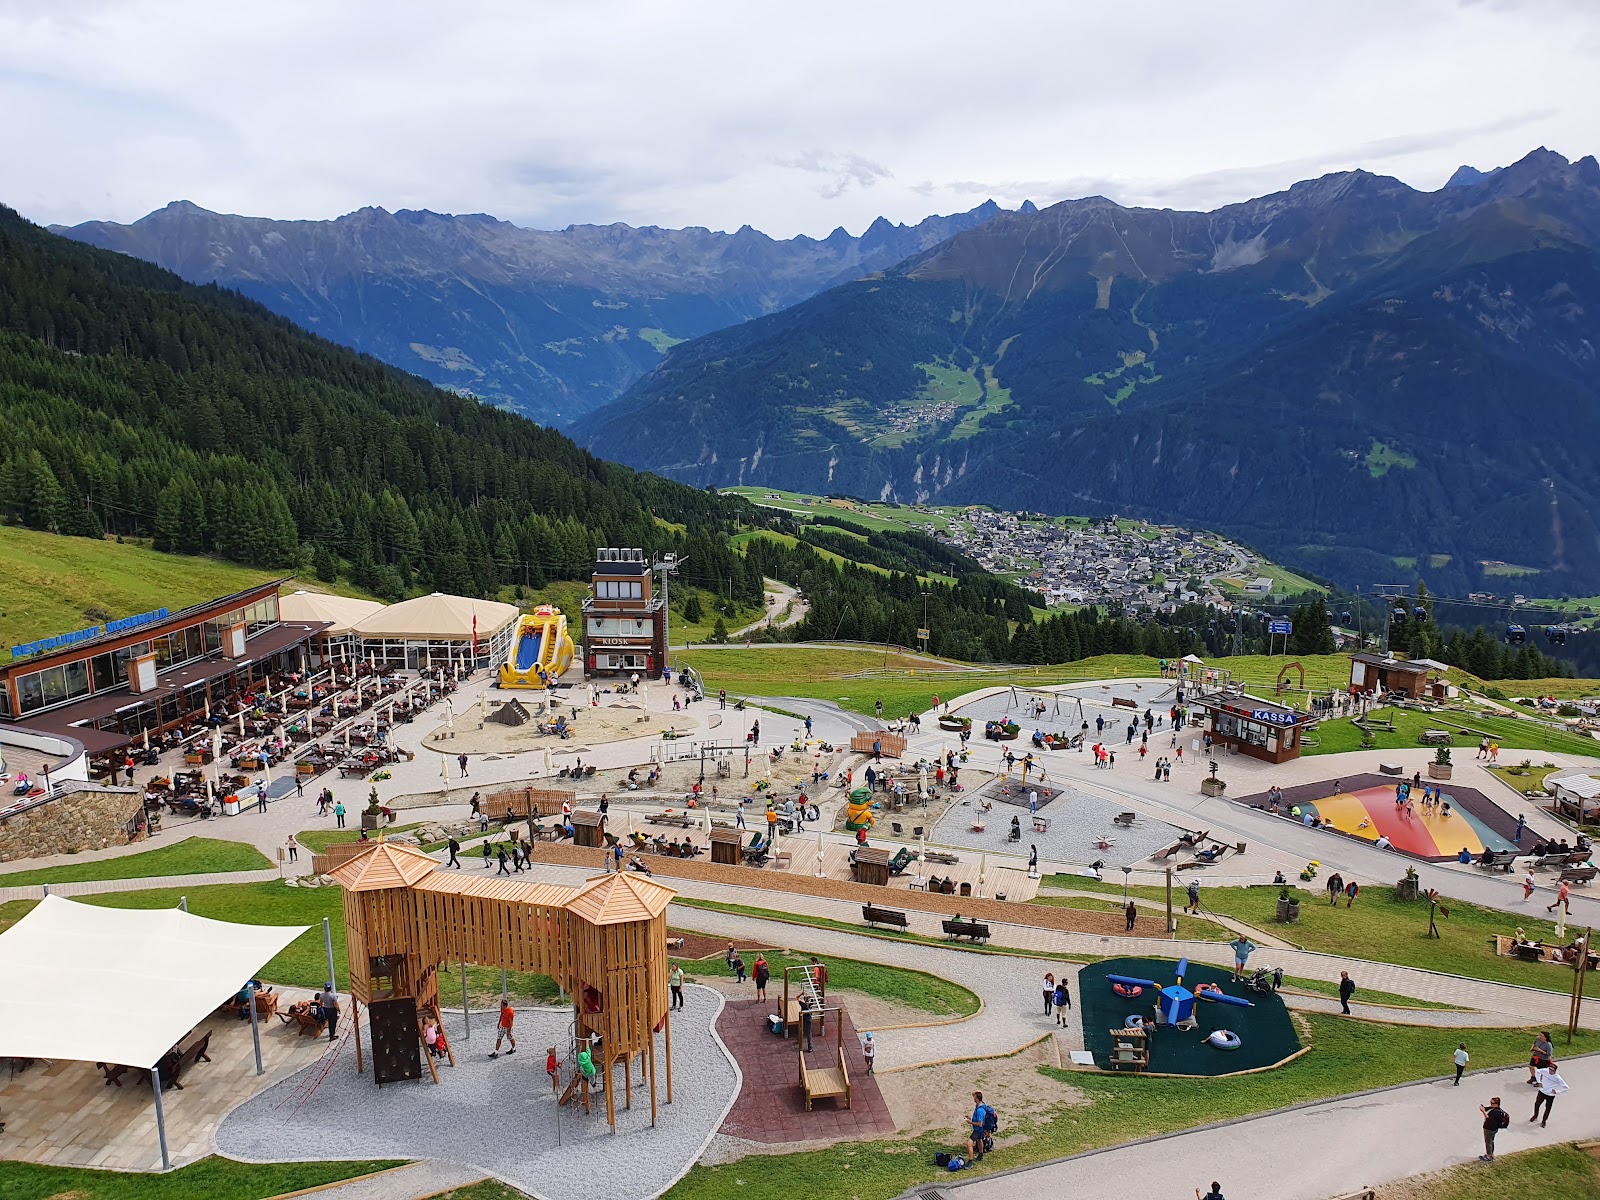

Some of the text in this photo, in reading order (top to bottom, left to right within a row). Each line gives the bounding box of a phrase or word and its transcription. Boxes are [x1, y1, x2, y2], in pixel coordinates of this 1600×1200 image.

[11, 607, 168, 657] RESTAURANT MOSERALM
[1254, 711, 1294, 723] KASSA
